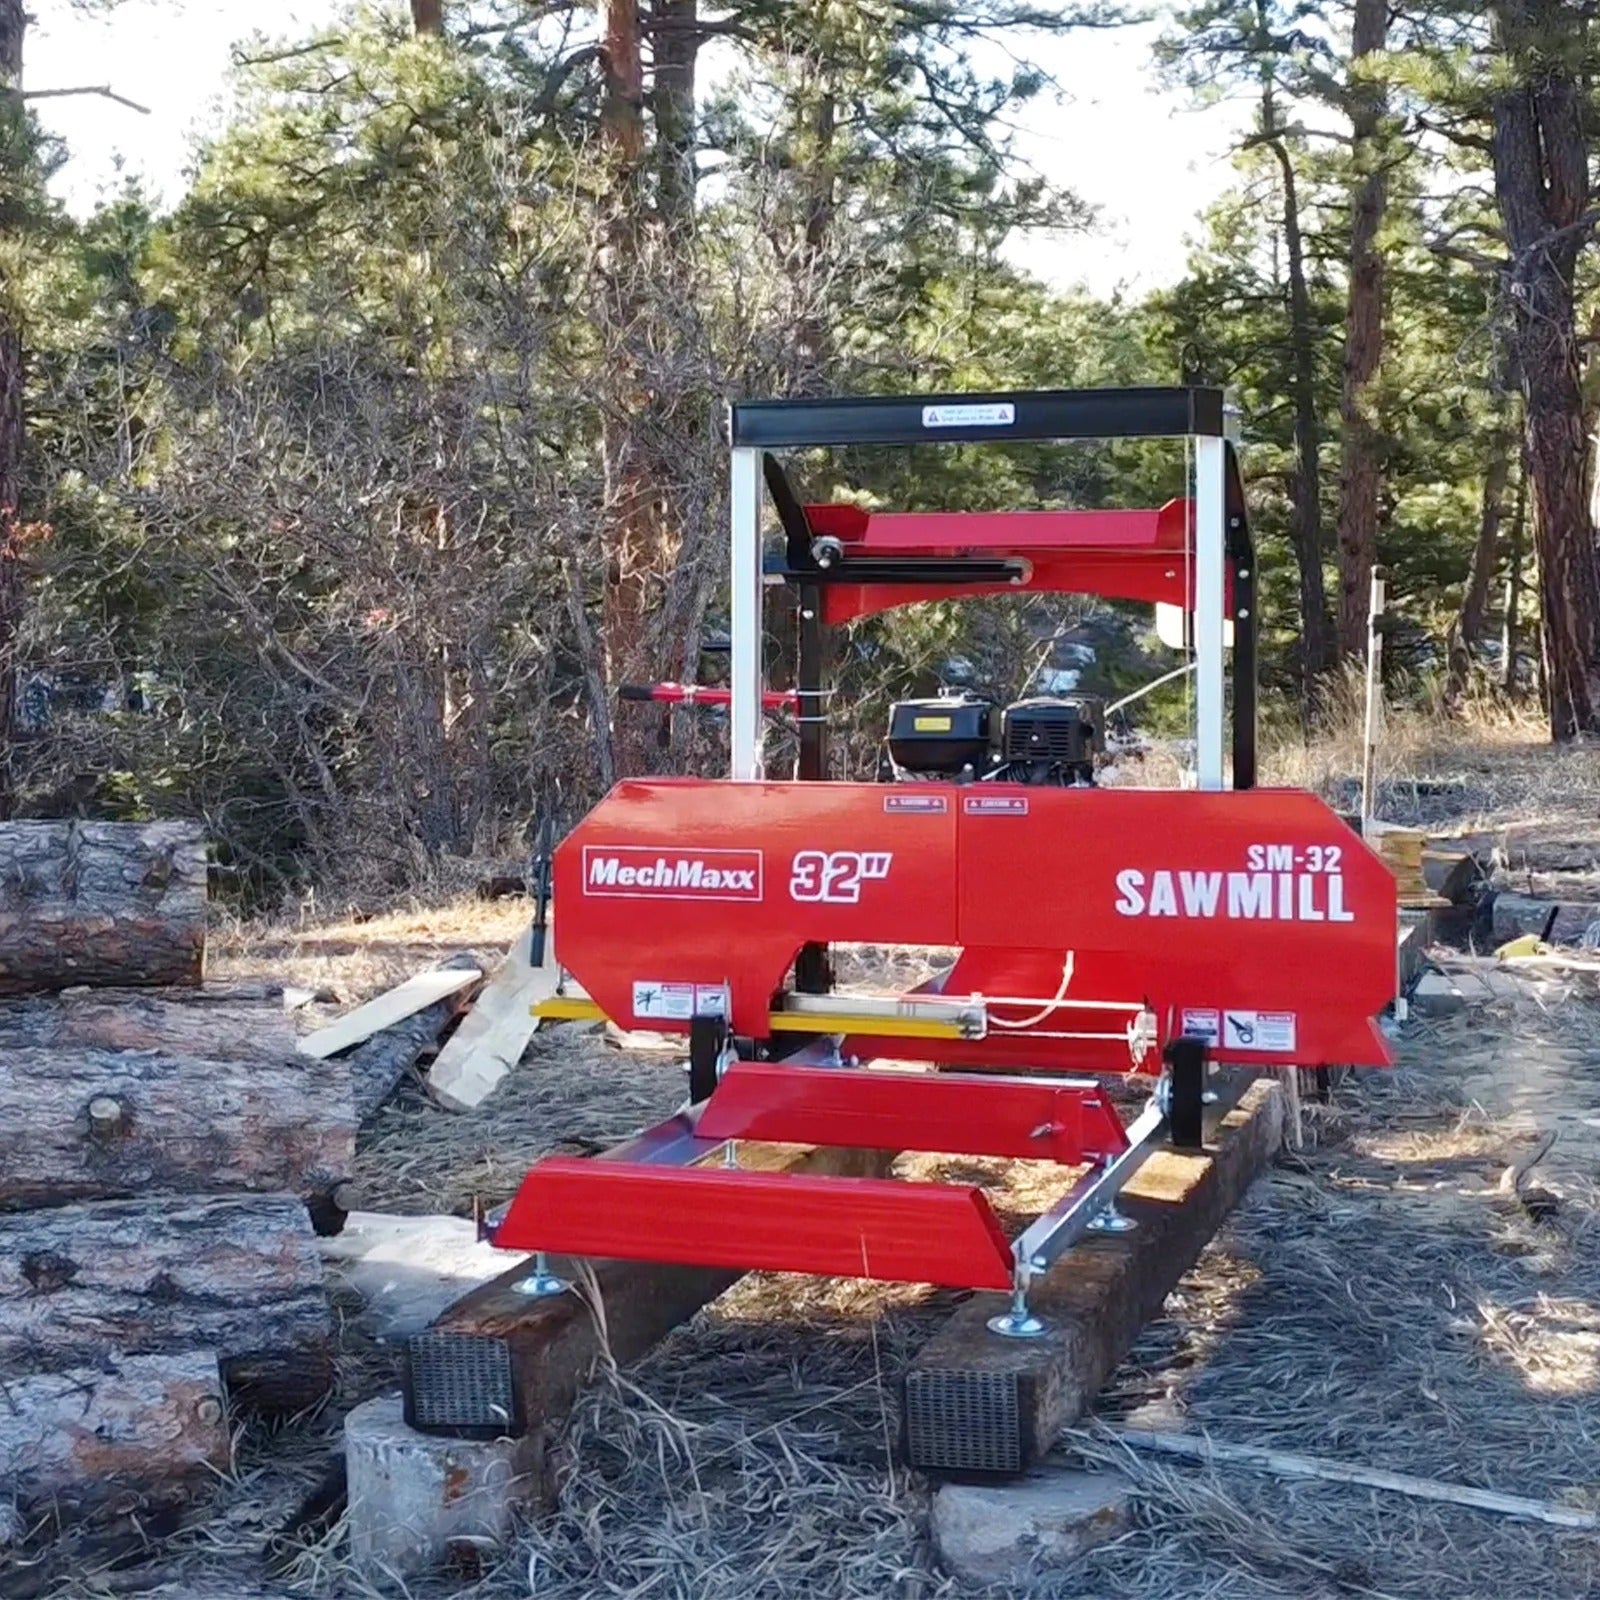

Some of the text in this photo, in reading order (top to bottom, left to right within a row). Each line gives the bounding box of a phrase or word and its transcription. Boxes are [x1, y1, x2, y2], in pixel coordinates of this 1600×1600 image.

[589, 857, 755, 890] MechMaxx
[1246, 844, 1342, 873] SM-32
[1114, 868, 1355, 922] SAWMILL
